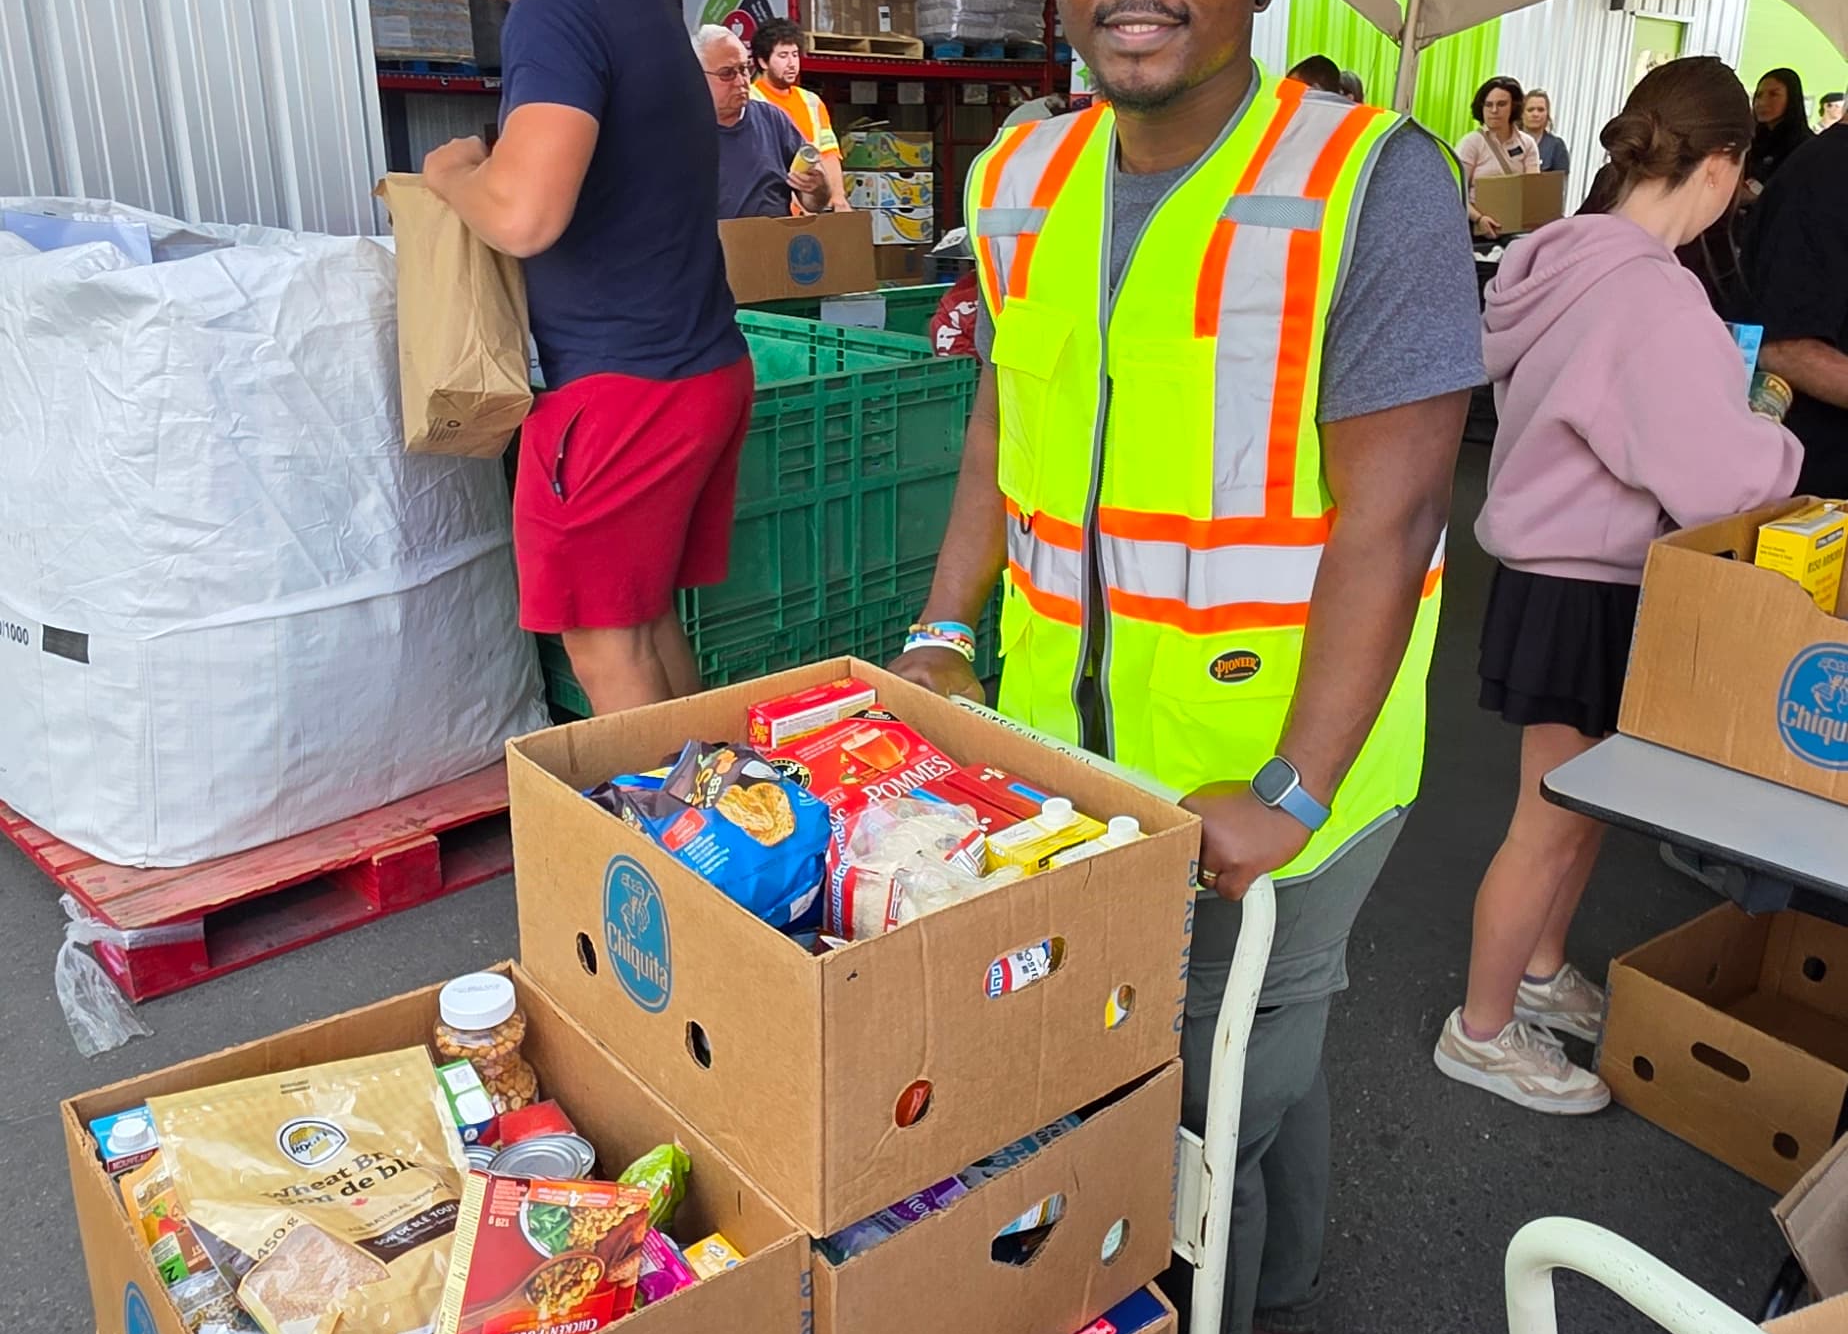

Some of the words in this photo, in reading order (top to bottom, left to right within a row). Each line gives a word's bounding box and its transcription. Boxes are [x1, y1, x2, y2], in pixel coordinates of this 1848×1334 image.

[1215, 656, 1258, 678] PIONEER
[1781, 700, 1848, 746] Chiqu
[861, 754, 952, 804] POMMES
[607, 921, 668, 993] Chiquita
[260, 1166, 352, 1199] Wheat
[339, 1175, 376, 1198] de
[568, 1190, 583, 1207] 4
[256, 1227, 287, 1261] 450
[286, 1216, 299, 1228] g
